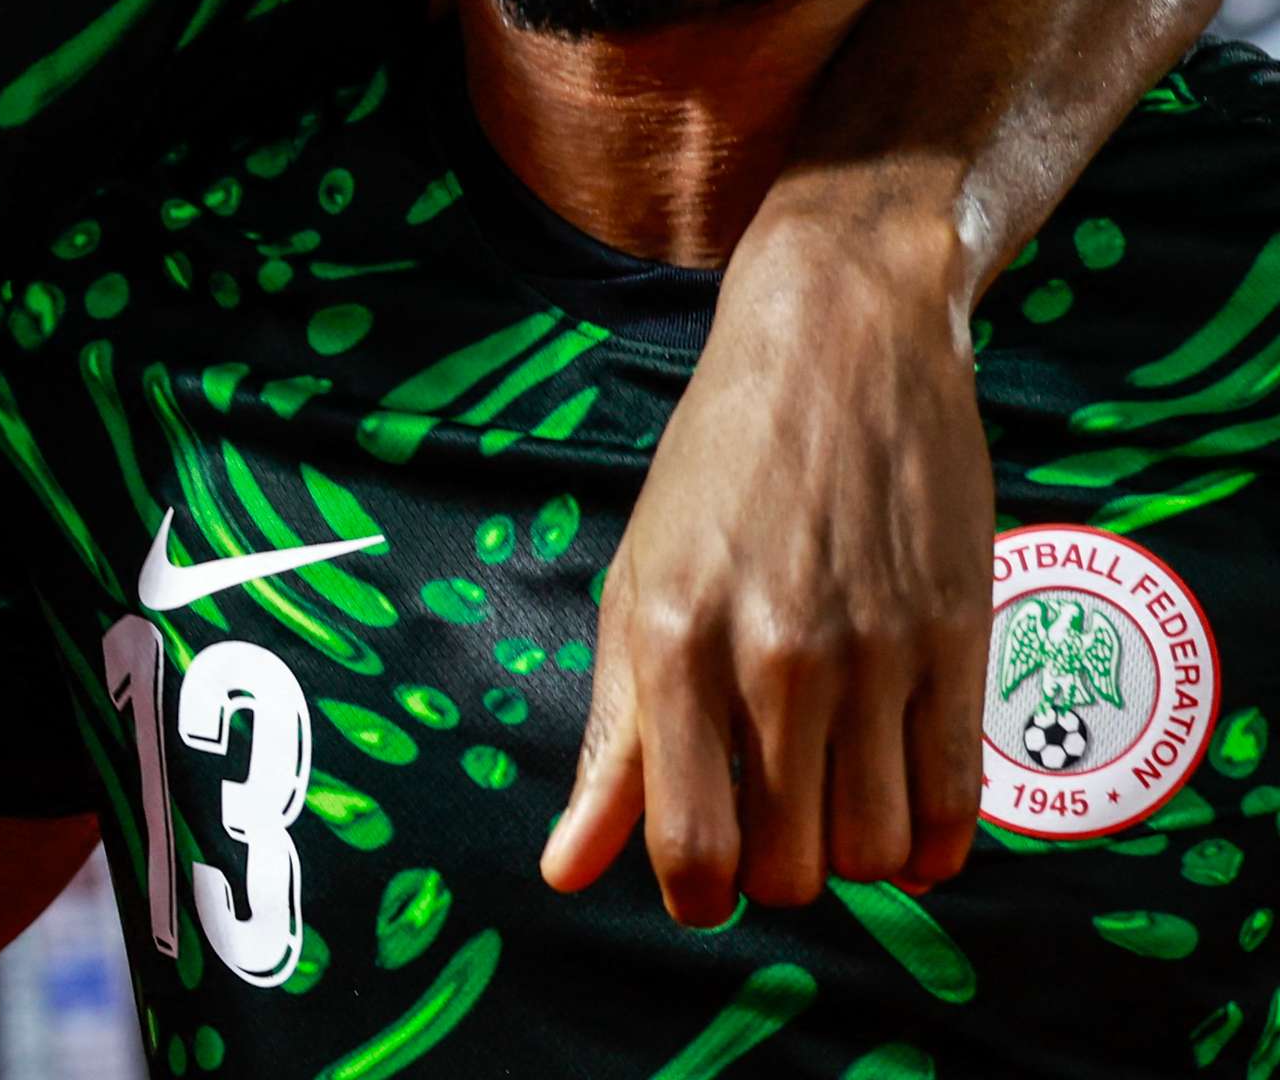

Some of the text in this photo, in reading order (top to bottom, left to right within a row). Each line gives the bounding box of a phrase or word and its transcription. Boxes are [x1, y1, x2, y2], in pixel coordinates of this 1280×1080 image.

[992, 542, 1202, 790] OTBALL FEDERATION
[102, 614, 312, 988] 13
[1012, 782, 1090, 818] 1945
